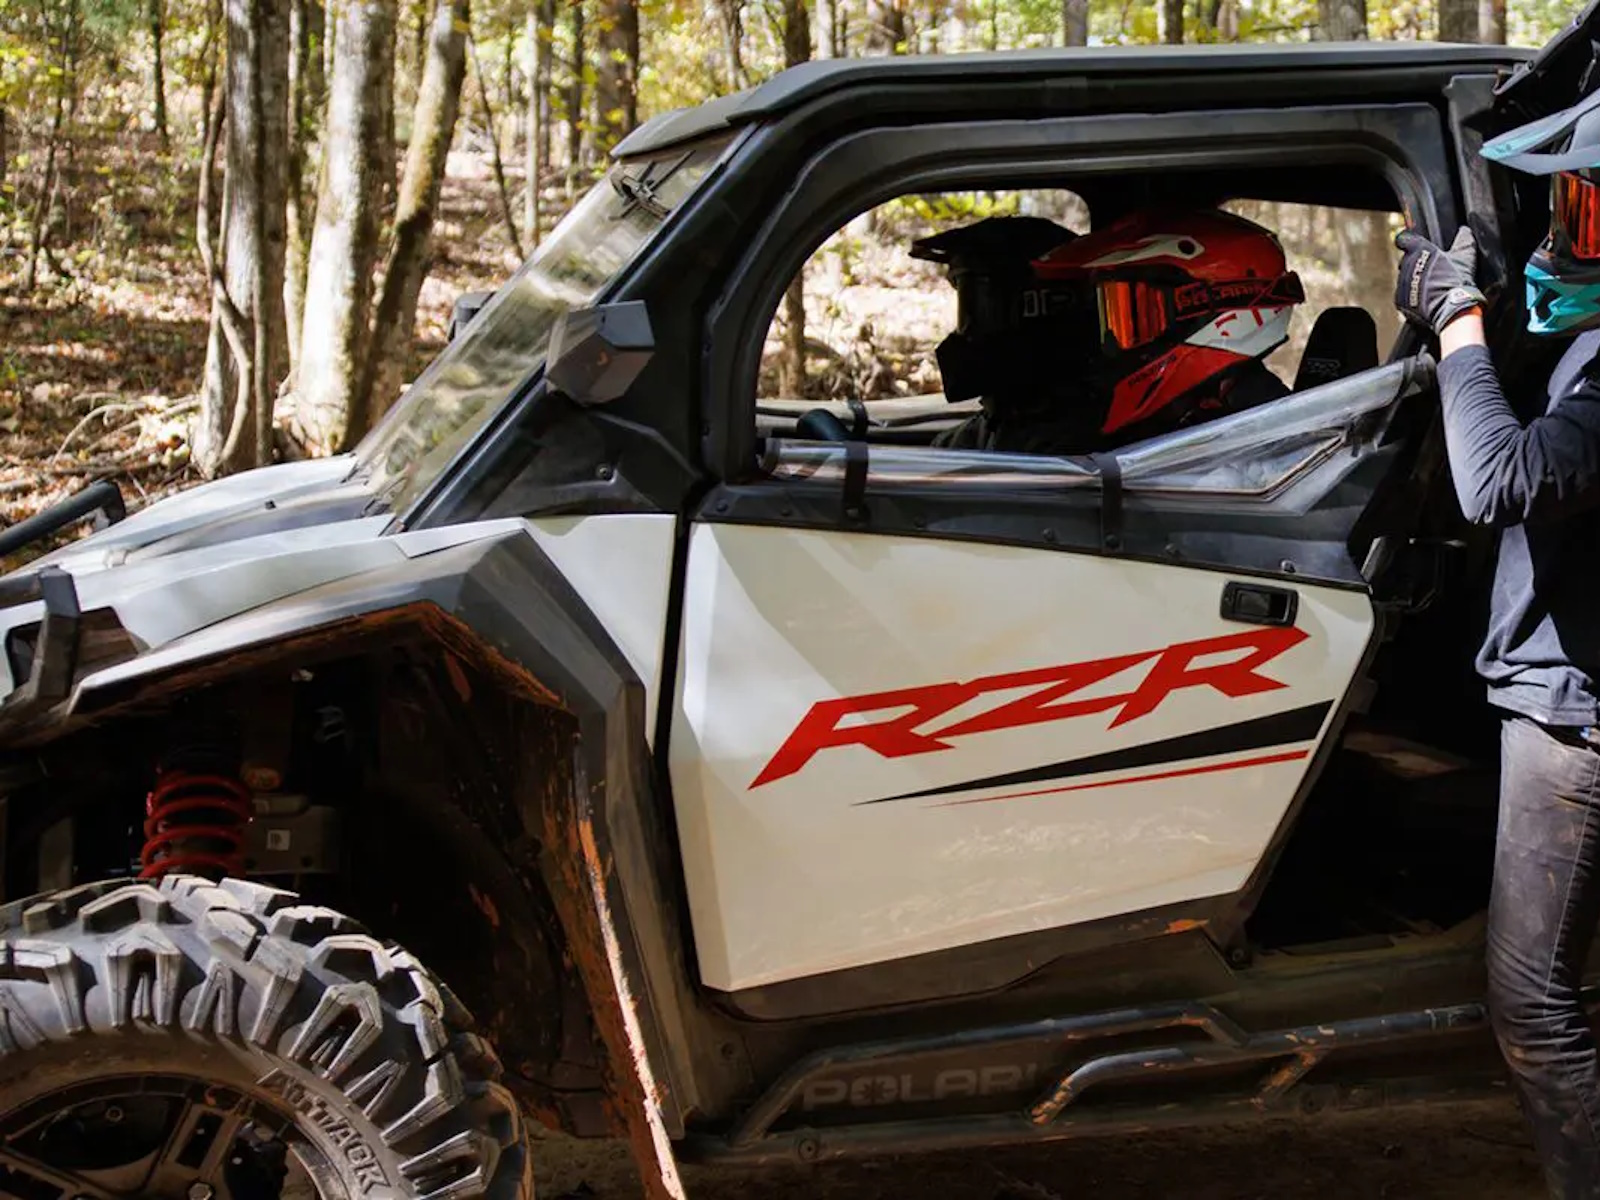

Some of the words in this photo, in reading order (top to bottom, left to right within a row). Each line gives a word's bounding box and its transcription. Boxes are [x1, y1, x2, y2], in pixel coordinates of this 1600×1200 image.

[748, 624, 1310, 790] RZR
[256, 1067, 392, 1195] ATTACK
[802, 1062, 1038, 1112] POLARI
